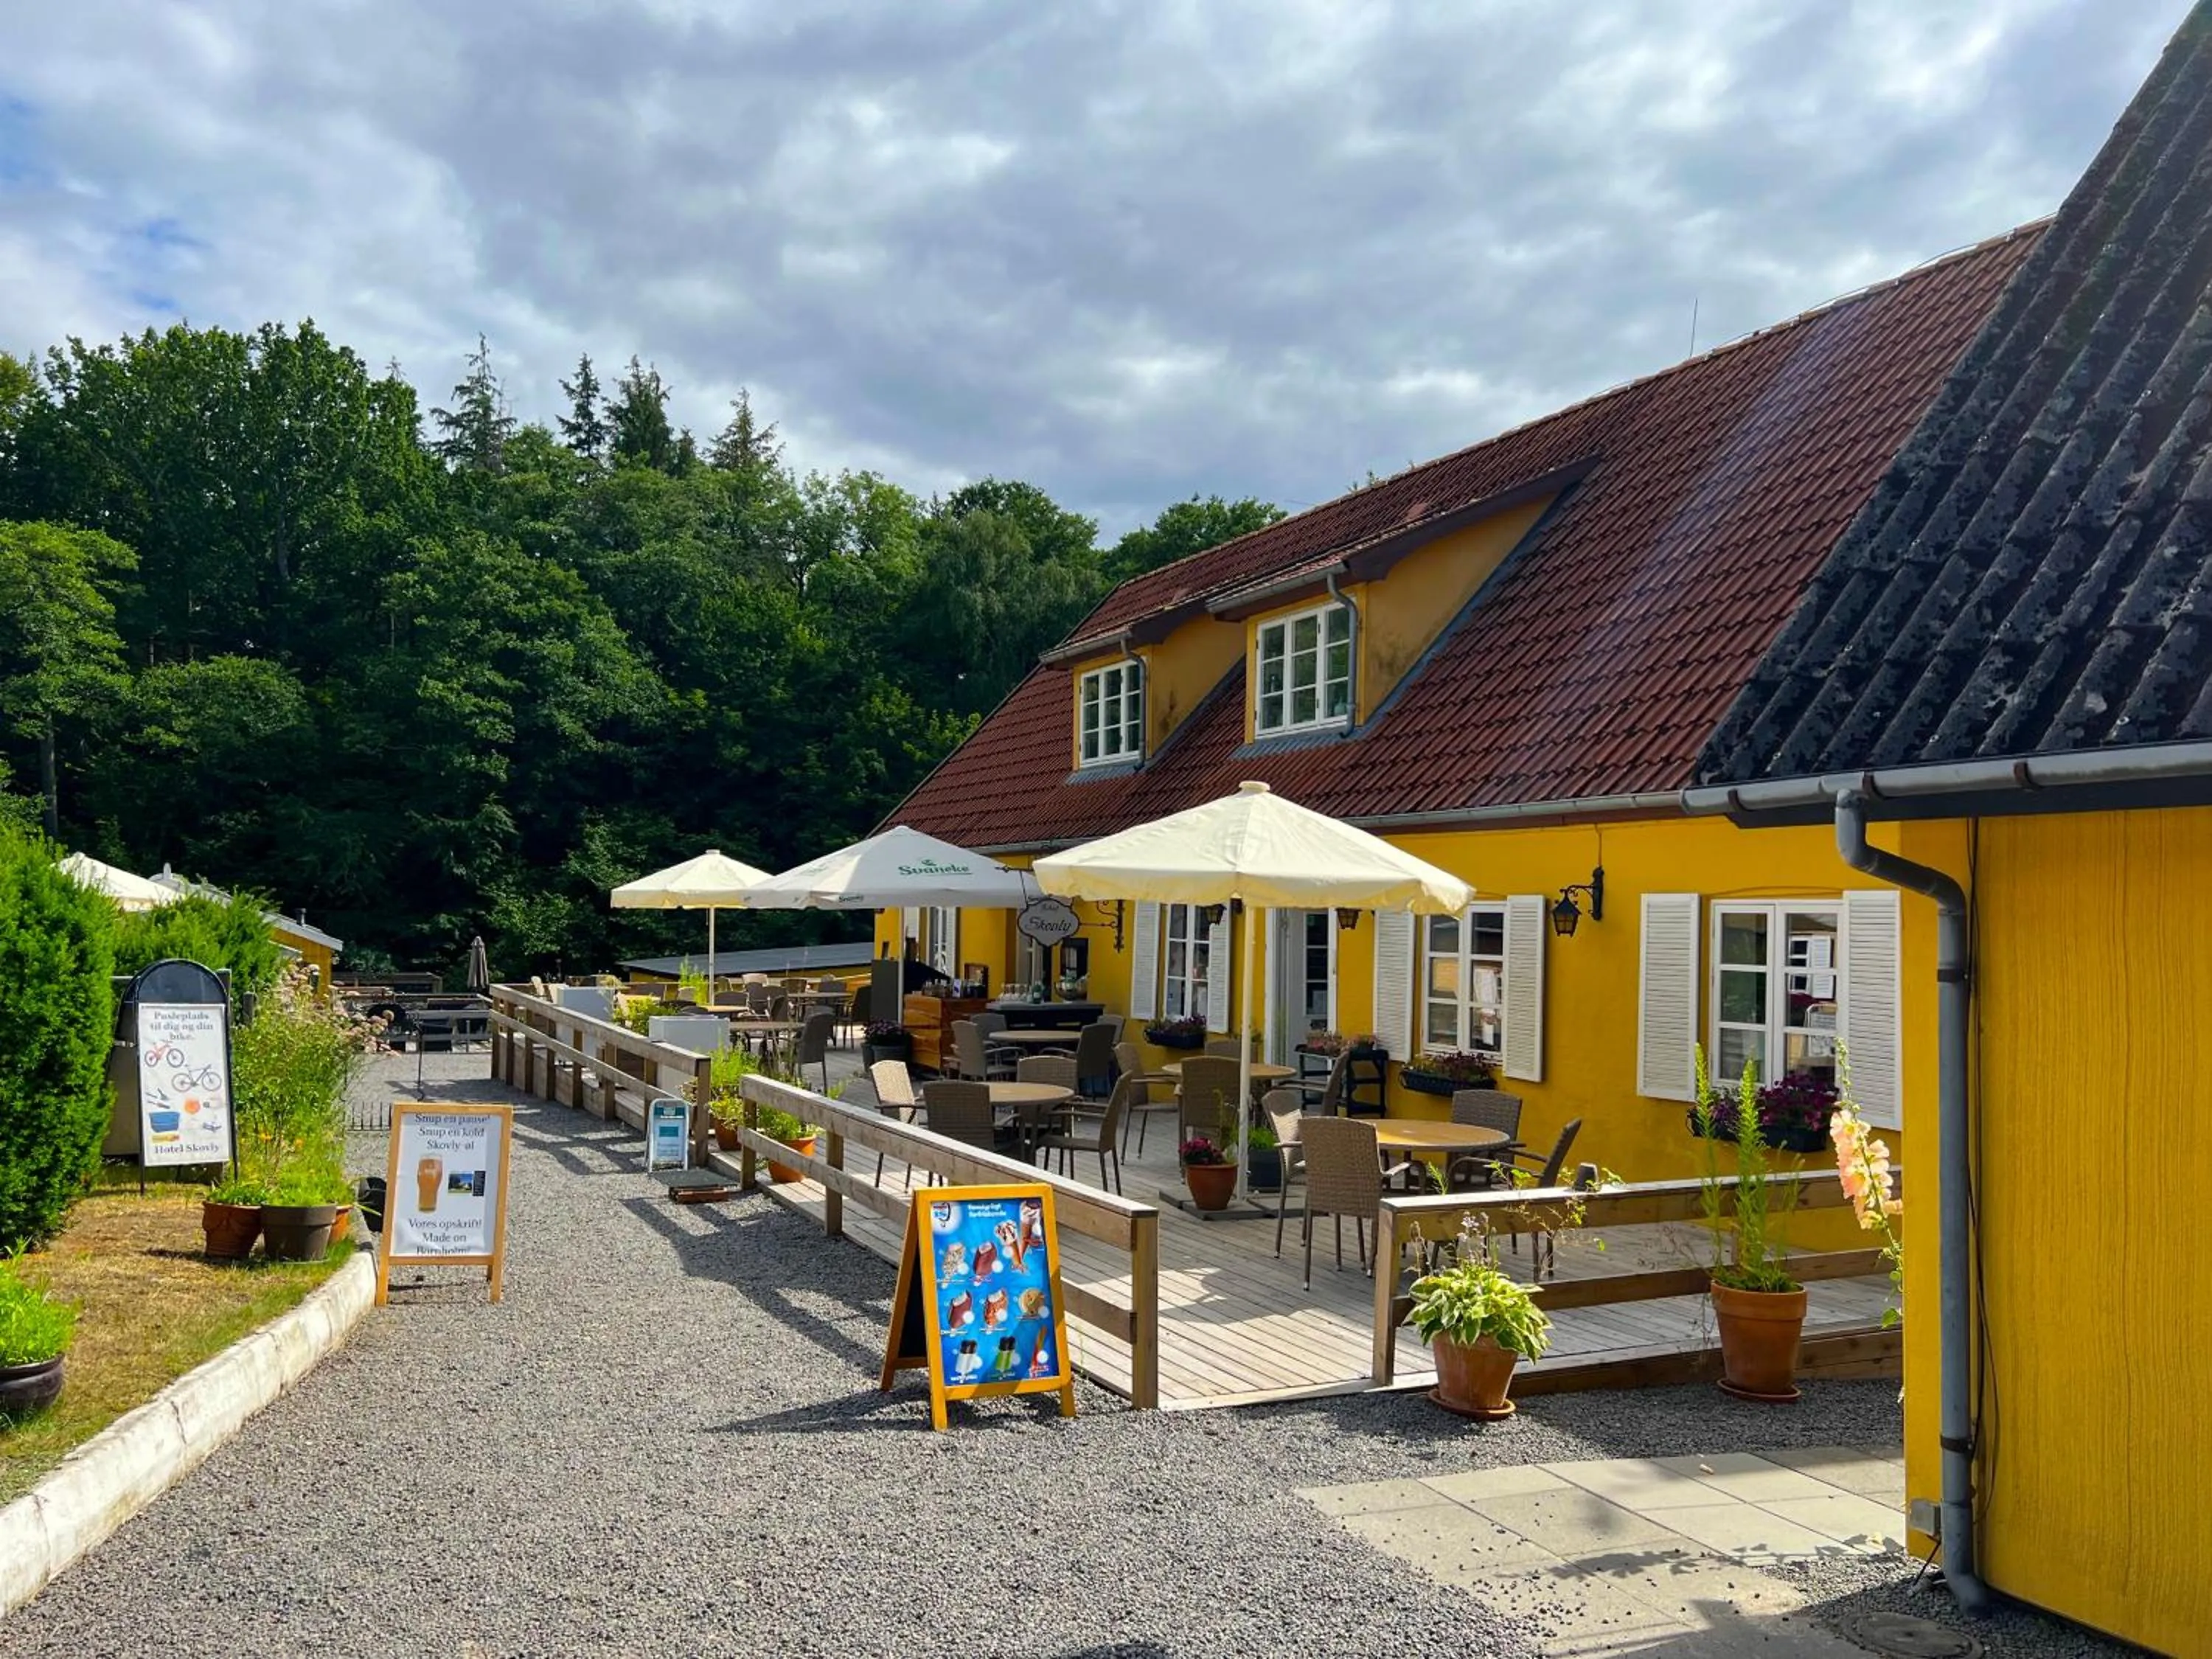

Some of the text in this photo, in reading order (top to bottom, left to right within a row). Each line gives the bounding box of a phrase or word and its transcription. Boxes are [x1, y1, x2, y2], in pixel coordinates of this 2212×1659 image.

[898, 864, 970, 875] Svaneke
[154, 1011, 209, 1020] Pusleplads
[150, 1021, 214, 1032] til dig og din
[415, 1113, 442, 1125] Snup
[419, 1127, 446, 1138] Snup
[462, 1127, 484, 1138] kold
[155, 1142, 220, 1154] Hotel Skovly
[408, 1218, 482, 1232] Vores opskrift!
[422, 1232, 451, 1243] Made
